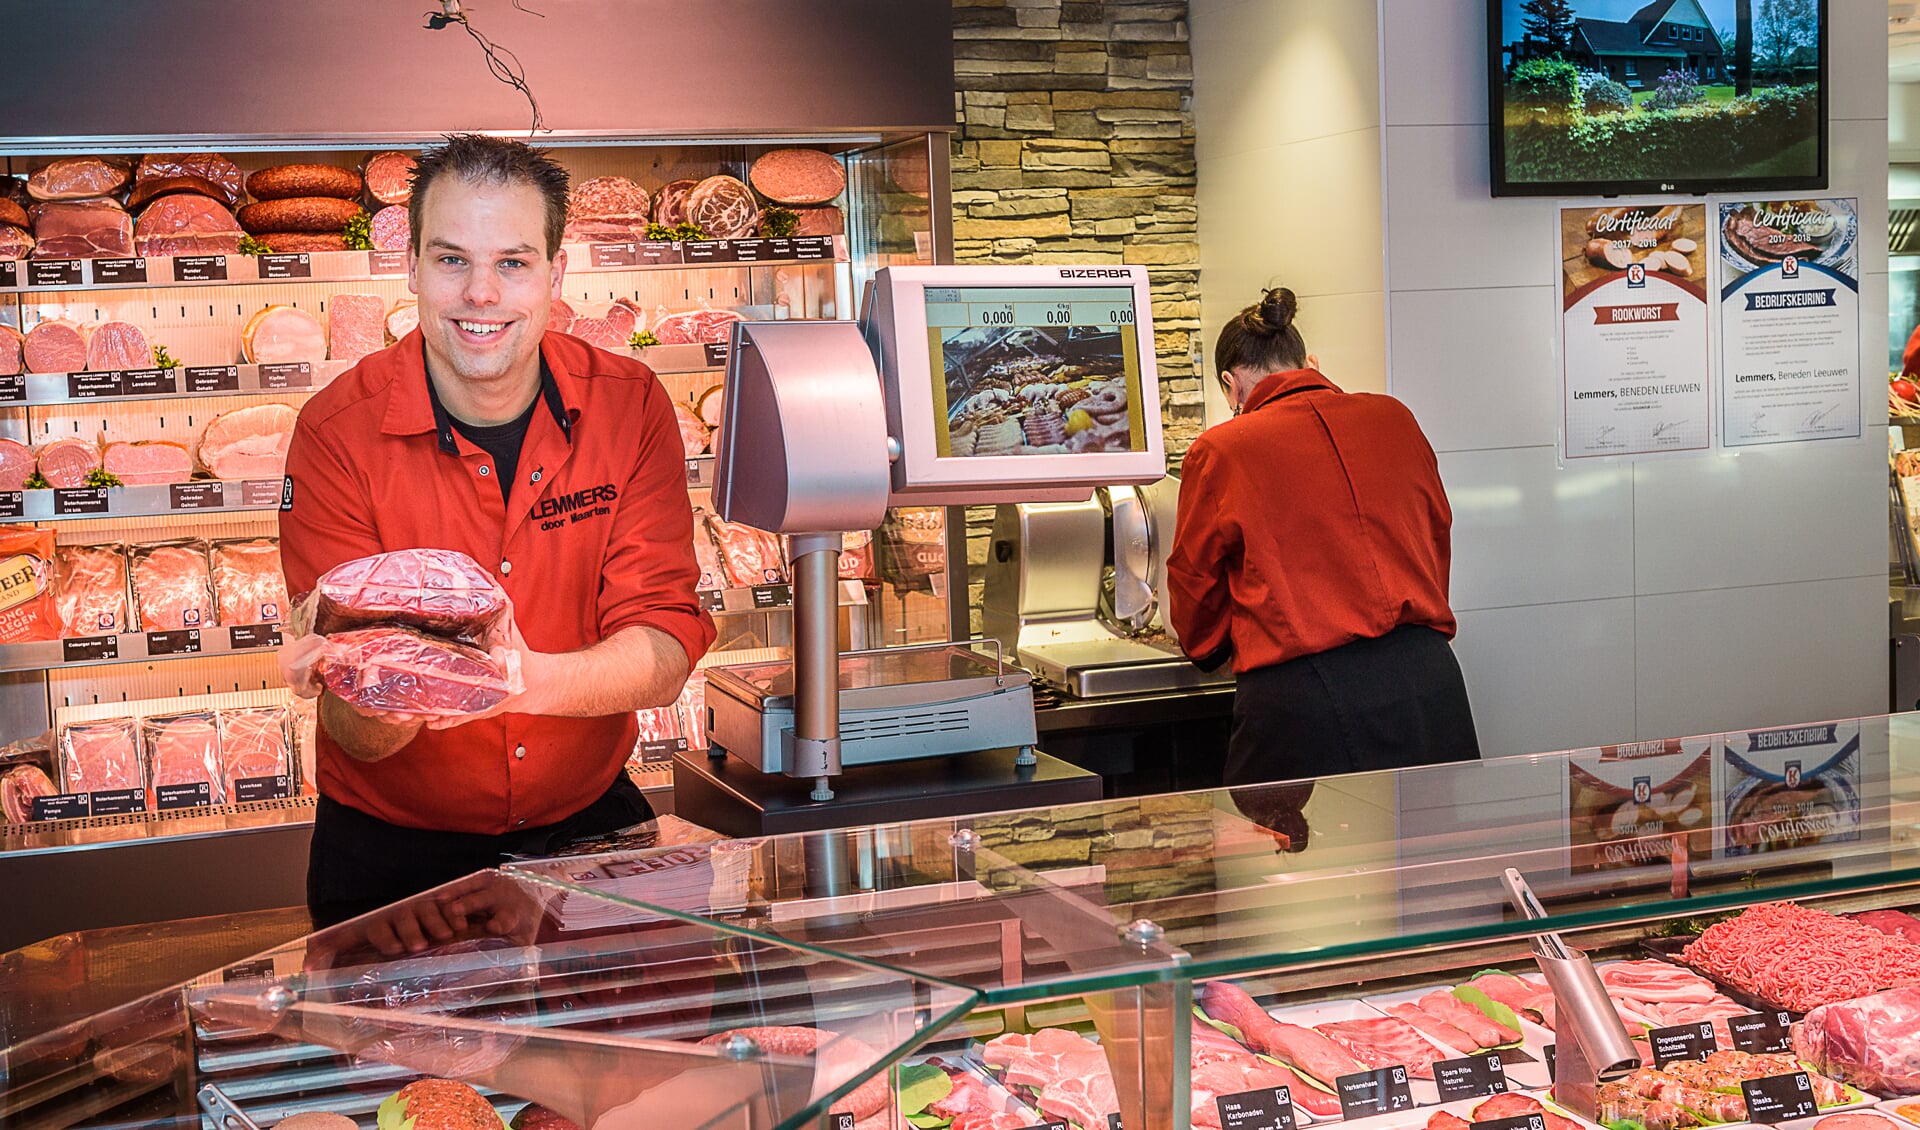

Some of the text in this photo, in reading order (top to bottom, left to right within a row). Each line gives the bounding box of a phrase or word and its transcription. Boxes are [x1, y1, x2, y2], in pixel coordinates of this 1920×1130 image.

[1596, 210, 1678, 235] Certificaat
[1753, 206, 1831, 230] Certificaat
[1612, 239, 1632, 249] 2017
[1639, 239, 1658, 248] 2018
[1768, 235, 1787, 244] 2017
[1793, 233, 1811, 242] 2018
[1059, 269, 1132, 279] BIZERBA
[1755, 292, 1826, 308] BEDRIJFSKEURING
[982, 311, 1014, 325] 0,000
[1047, 310, 1071, 324] 0,00
[1110, 310, 1133, 324] 0,00
[1612, 306, 1662, 322] ROOKWORST
[1735, 368, 1848, 383] Lemmers, Beneden Leeuwen
[1574, 383, 1701, 400] Lemmers, BENEDEN LEEUWEN
[530, 484, 618, 520] LEMMERS
[541, 506, 611, 531] door Maarten
[0, 565, 36, 592] EER
[0, 611, 38, 636] LEGEN
[1736, 1022, 1766, 1032] Speklappen
[1657, 1033, 1695, 1044] Ongepaneerde
[1441, 1067, 1472, 1078] Spare Ribs
[1343, 1080, 1378, 1091] Varkenshaas
[1225, 1103, 1241, 1111] Haas
[1226, 1109, 1264, 1120] Karbonaden
